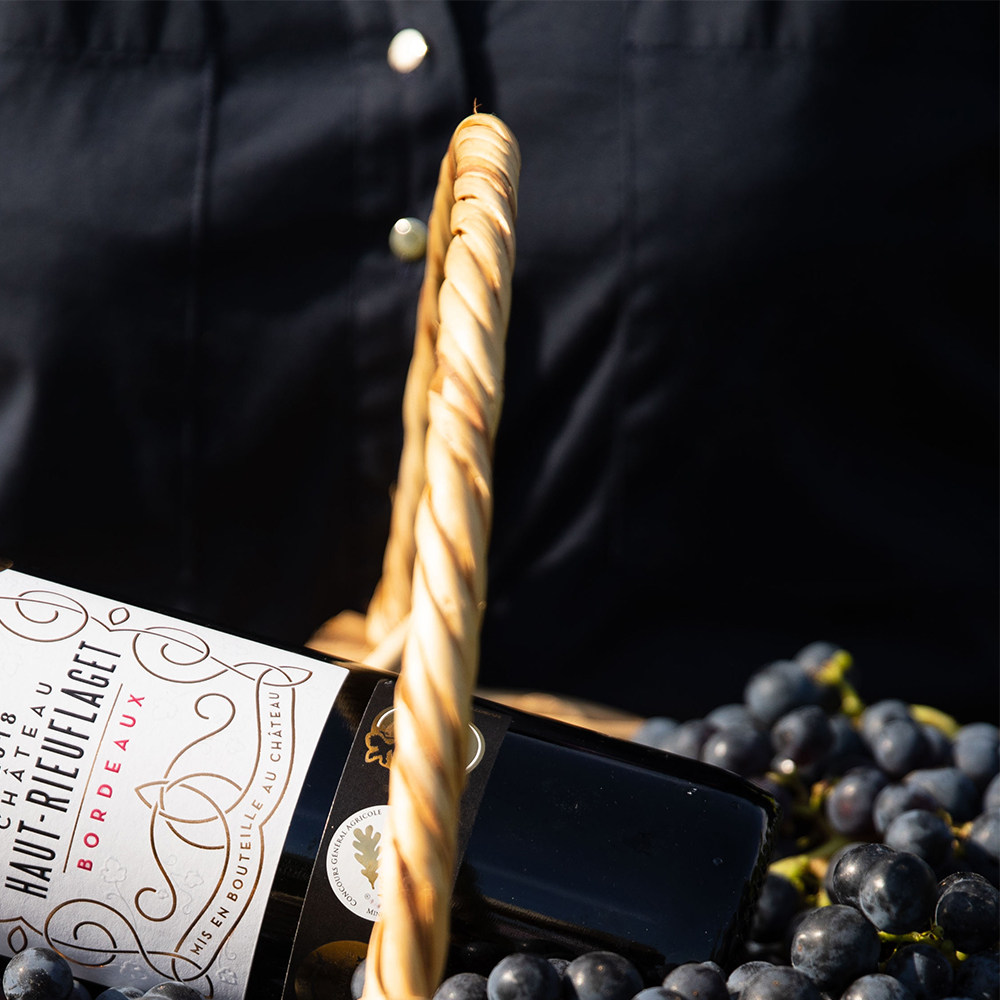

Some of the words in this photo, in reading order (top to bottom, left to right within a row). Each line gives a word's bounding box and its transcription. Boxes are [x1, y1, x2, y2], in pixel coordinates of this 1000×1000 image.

[268, 692, 283, 762] CHÂTEAU
[4, 640, 121, 899] HAUT-RIEUFLAGET
[77, 694, 145, 871] BORDEAUX
[262, 771, 278, 794] AU
[226, 800, 264, 902] BOUTEILLE
[331, 867, 358, 907] CONCOURS
[346, 809, 383, 832] AGRICOLE
[189, 930, 213, 955] MIS
[210, 906, 231, 928] EN
